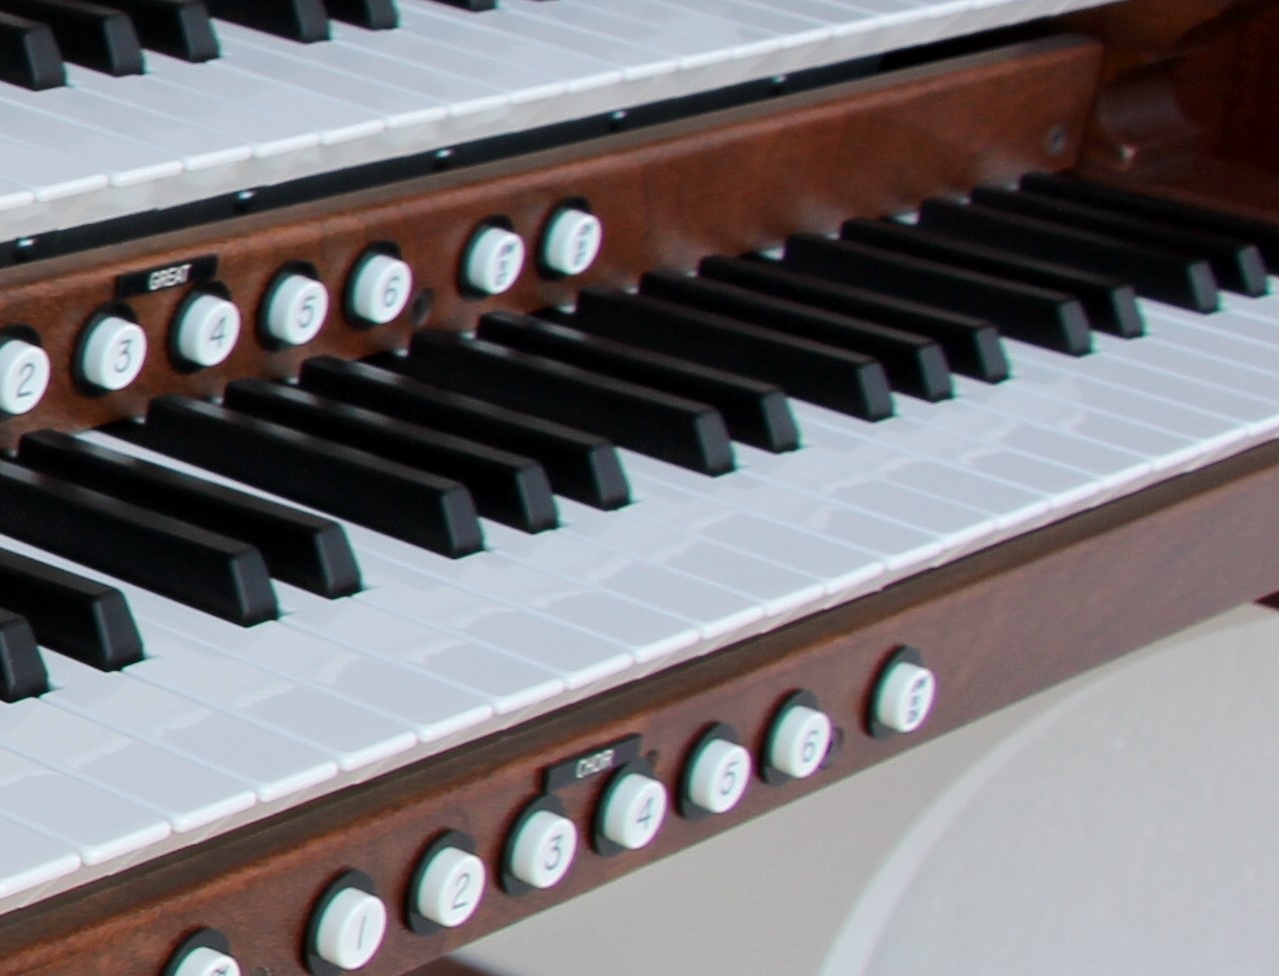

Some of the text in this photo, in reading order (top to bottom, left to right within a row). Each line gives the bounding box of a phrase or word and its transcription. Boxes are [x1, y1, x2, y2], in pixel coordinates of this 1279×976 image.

[148, 264, 192, 291] GREAT
[382, 275, 401, 307] 6
[298, 295, 317, 329] 5
[208, 315, 228, 348] 4
[114, 339, 133, 373] 3
[16, 362, 35, 398] 2
[801, 729, 820, 762] 6
[575, 749, 616, 779] CHOIR
[719, 761, 738, 795] 5
[636, 797, 656, 830] 4
[544, 835, 564, 871] 3
[451, 873, 471, 911] 2
[357, 915, 368, 951] 1
